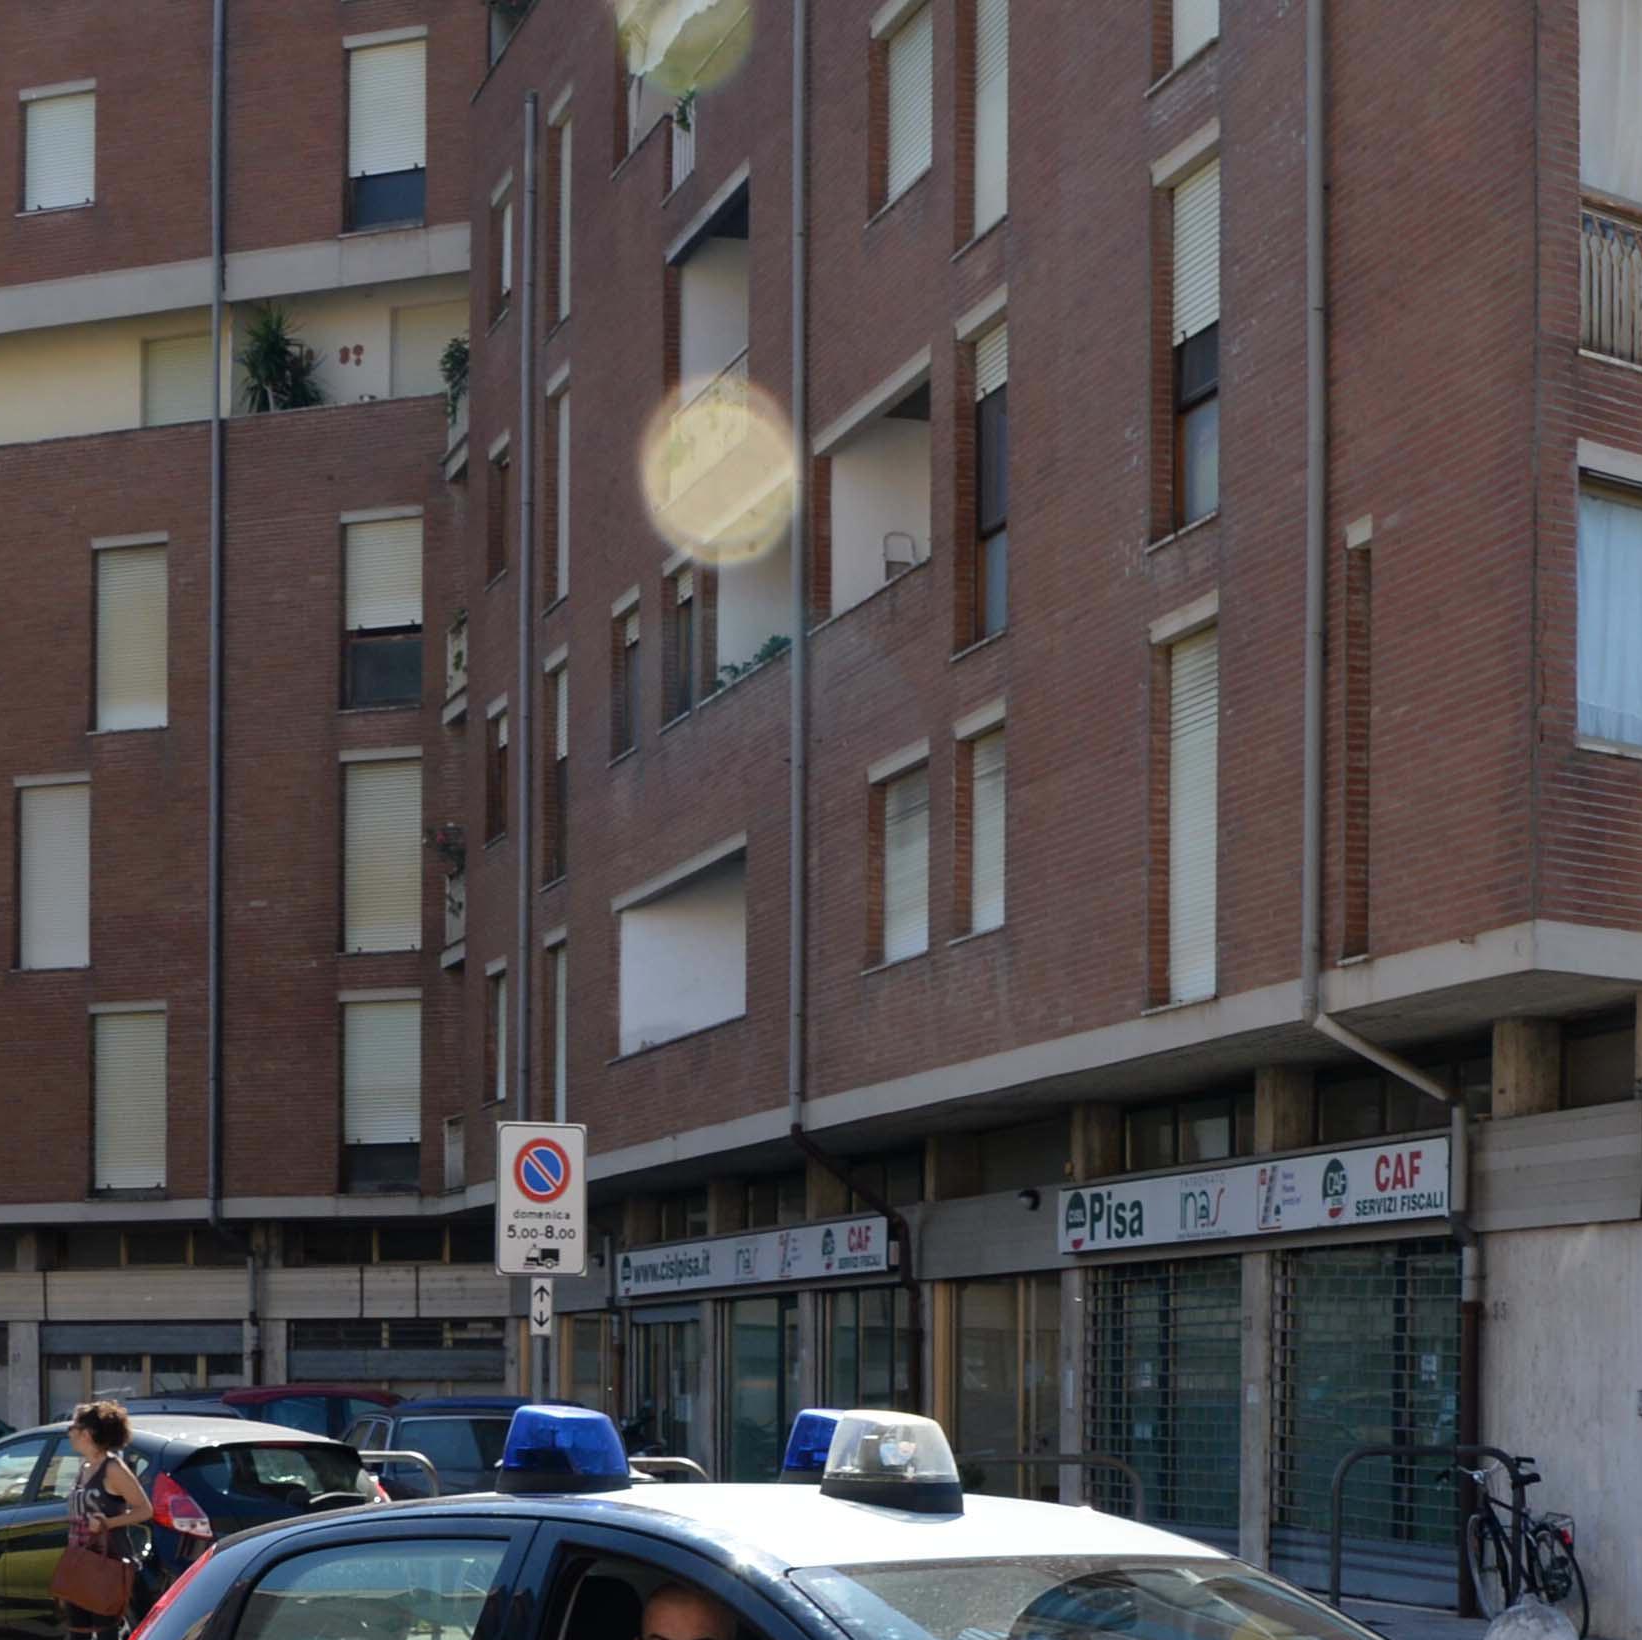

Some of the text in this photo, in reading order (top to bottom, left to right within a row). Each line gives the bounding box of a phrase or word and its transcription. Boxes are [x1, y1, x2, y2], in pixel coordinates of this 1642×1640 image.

[1375, 1151, 1422, 1192] CAF
[513, 1209, 570, 1220] domenica
[1089, 1191, 1143, 1241] Pisa
[1355, 1190, 1444, 1217] SERVIZI FISCALI
[848, 1226, 872, 1253] CAF
[631, 1248, 709, 1287] www.cislpisa.it
